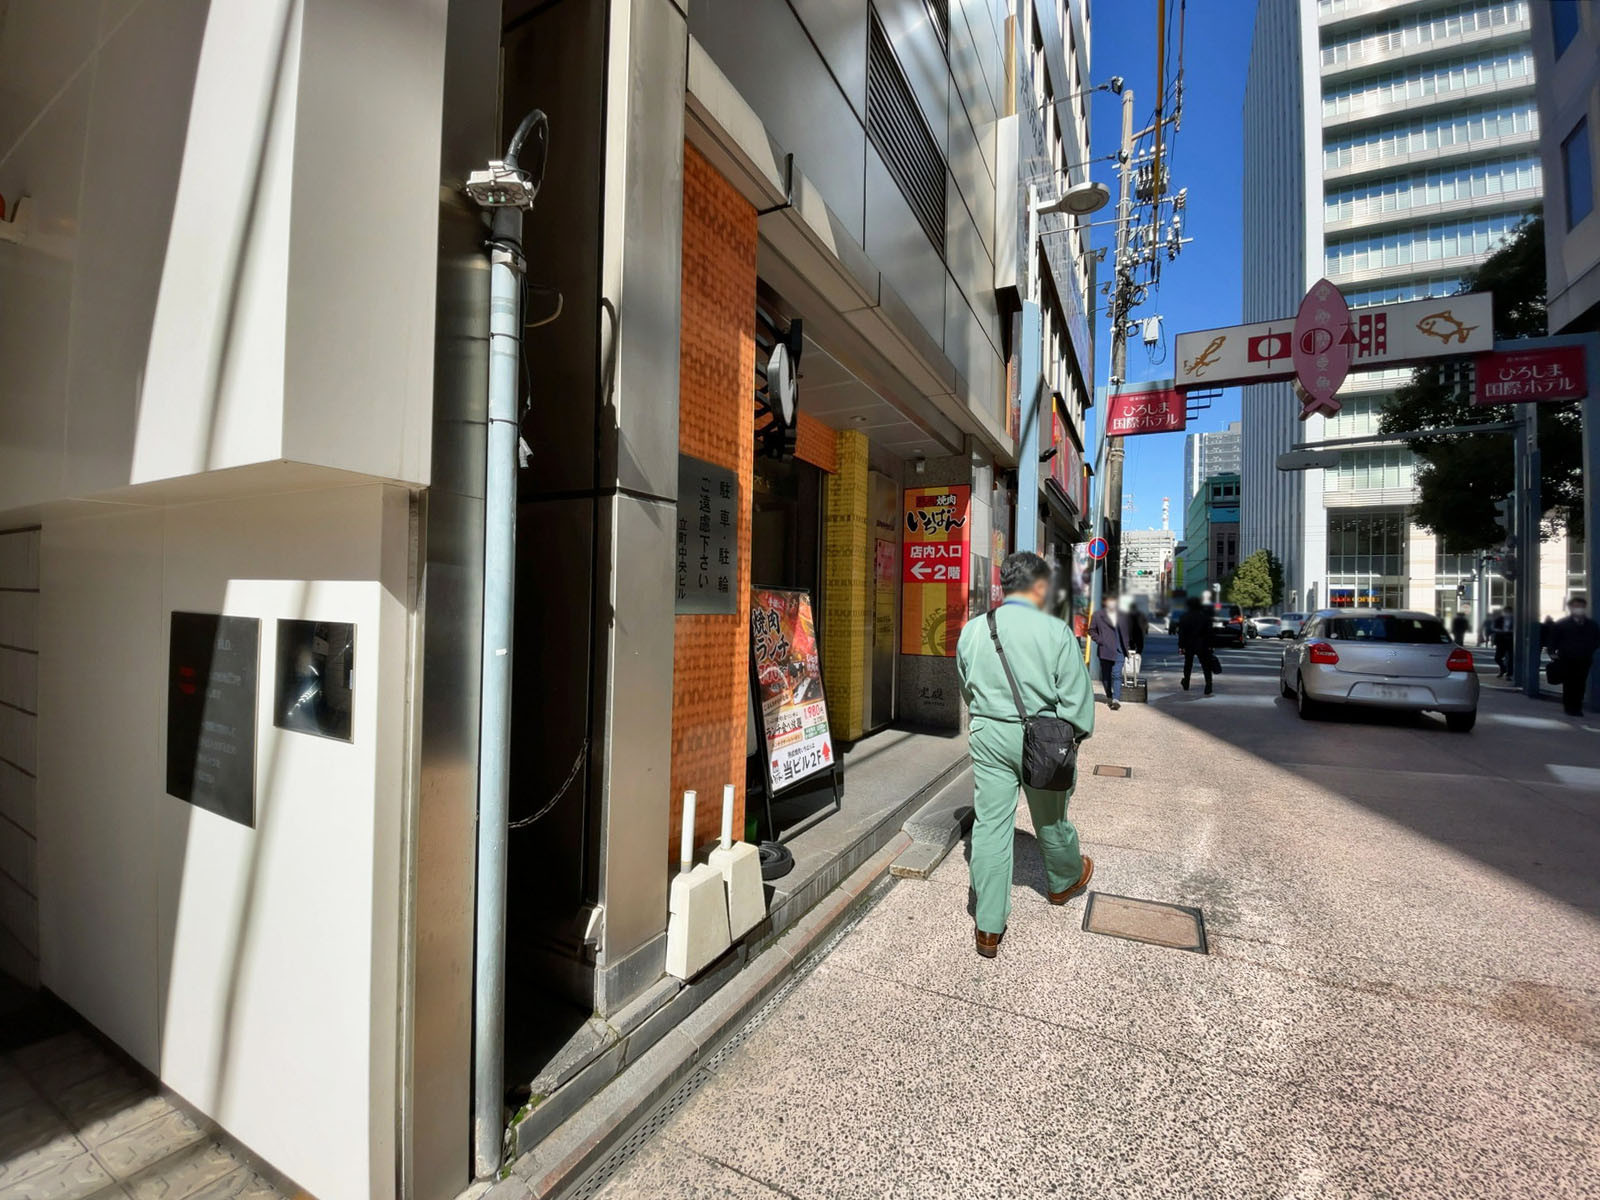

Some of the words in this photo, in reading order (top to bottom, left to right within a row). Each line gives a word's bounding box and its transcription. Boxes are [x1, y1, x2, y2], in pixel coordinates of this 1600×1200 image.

[1499, 363, 1563, 381] ひろしま
[1485, 377, 1577, 397] 国際ホテル
[1123, 401, 1170, 417] ひろしま
[1113, 413, 1179, 430] 国際ホテル
[936, 494, 957, 506] 焼肉
[906, 508, 966, 535] いちばん
[698, 477, 711, 589] ご遠慮下さい
[677, 517, 688, 600] 立町中央ビル
[910, 545, 962, 559] 店内入口
[933, 564, 961, 580] 2階
[752, 606, 780, 637] 焼肉
[755, 633, 789, 662] ランチ
[783, 749, 821, 780] 当ビル2F
